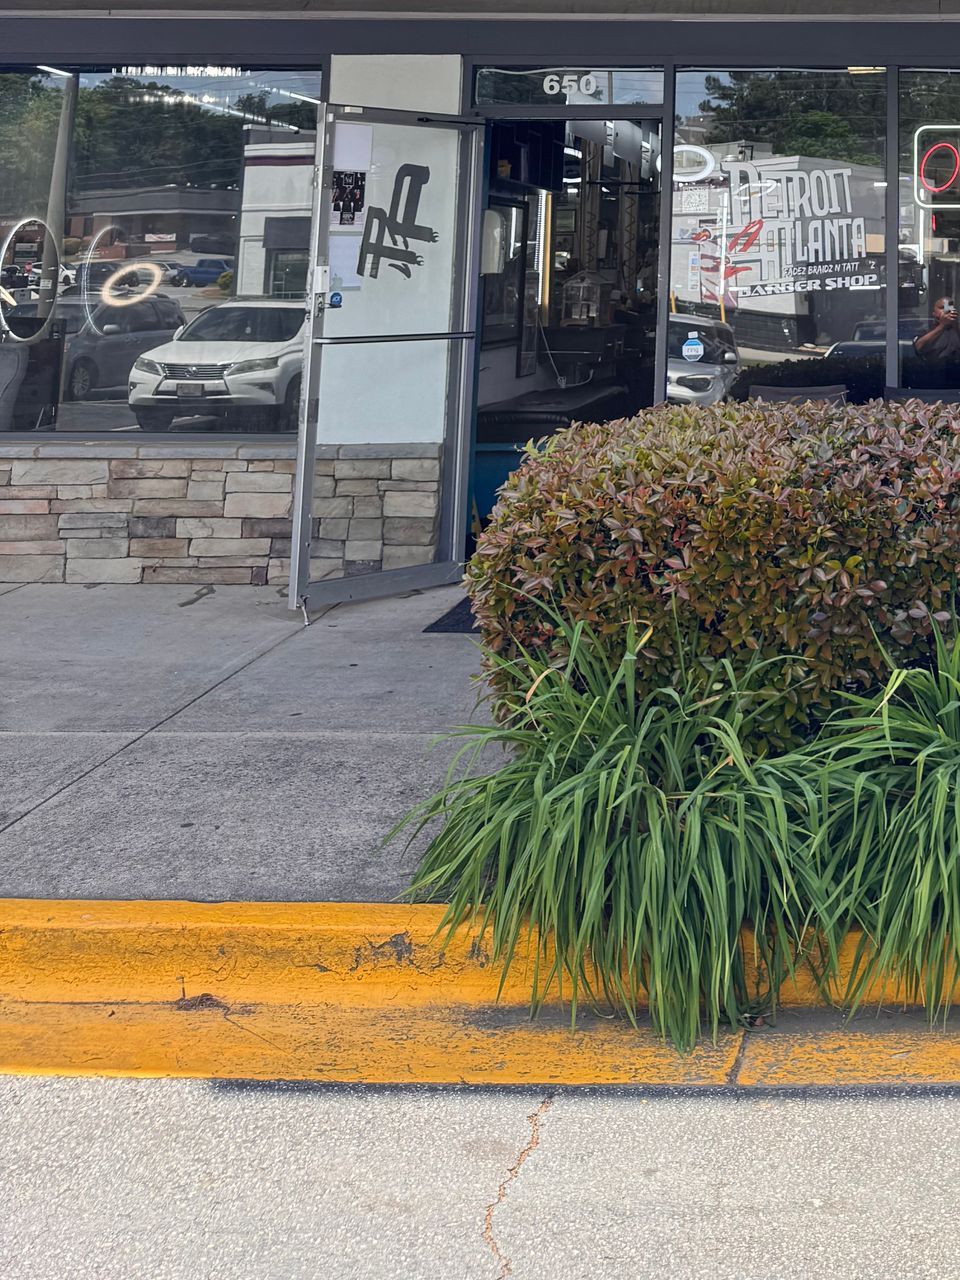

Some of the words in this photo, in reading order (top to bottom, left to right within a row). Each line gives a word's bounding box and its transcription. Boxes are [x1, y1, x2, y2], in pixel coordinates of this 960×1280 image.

[543, 75, 597, 95] 650
[720, 161, 852, 224] DETROIT
[760, 217, 867, 281] ATLANTA
[783, 266, 807, 278] FADEZ
[807, 263, 834, 275] BRAIDZ
[834, 263, 841, 272] N
[738, 279, 822, 299] BARBER
[825, 274, 878, 290] SHOP
